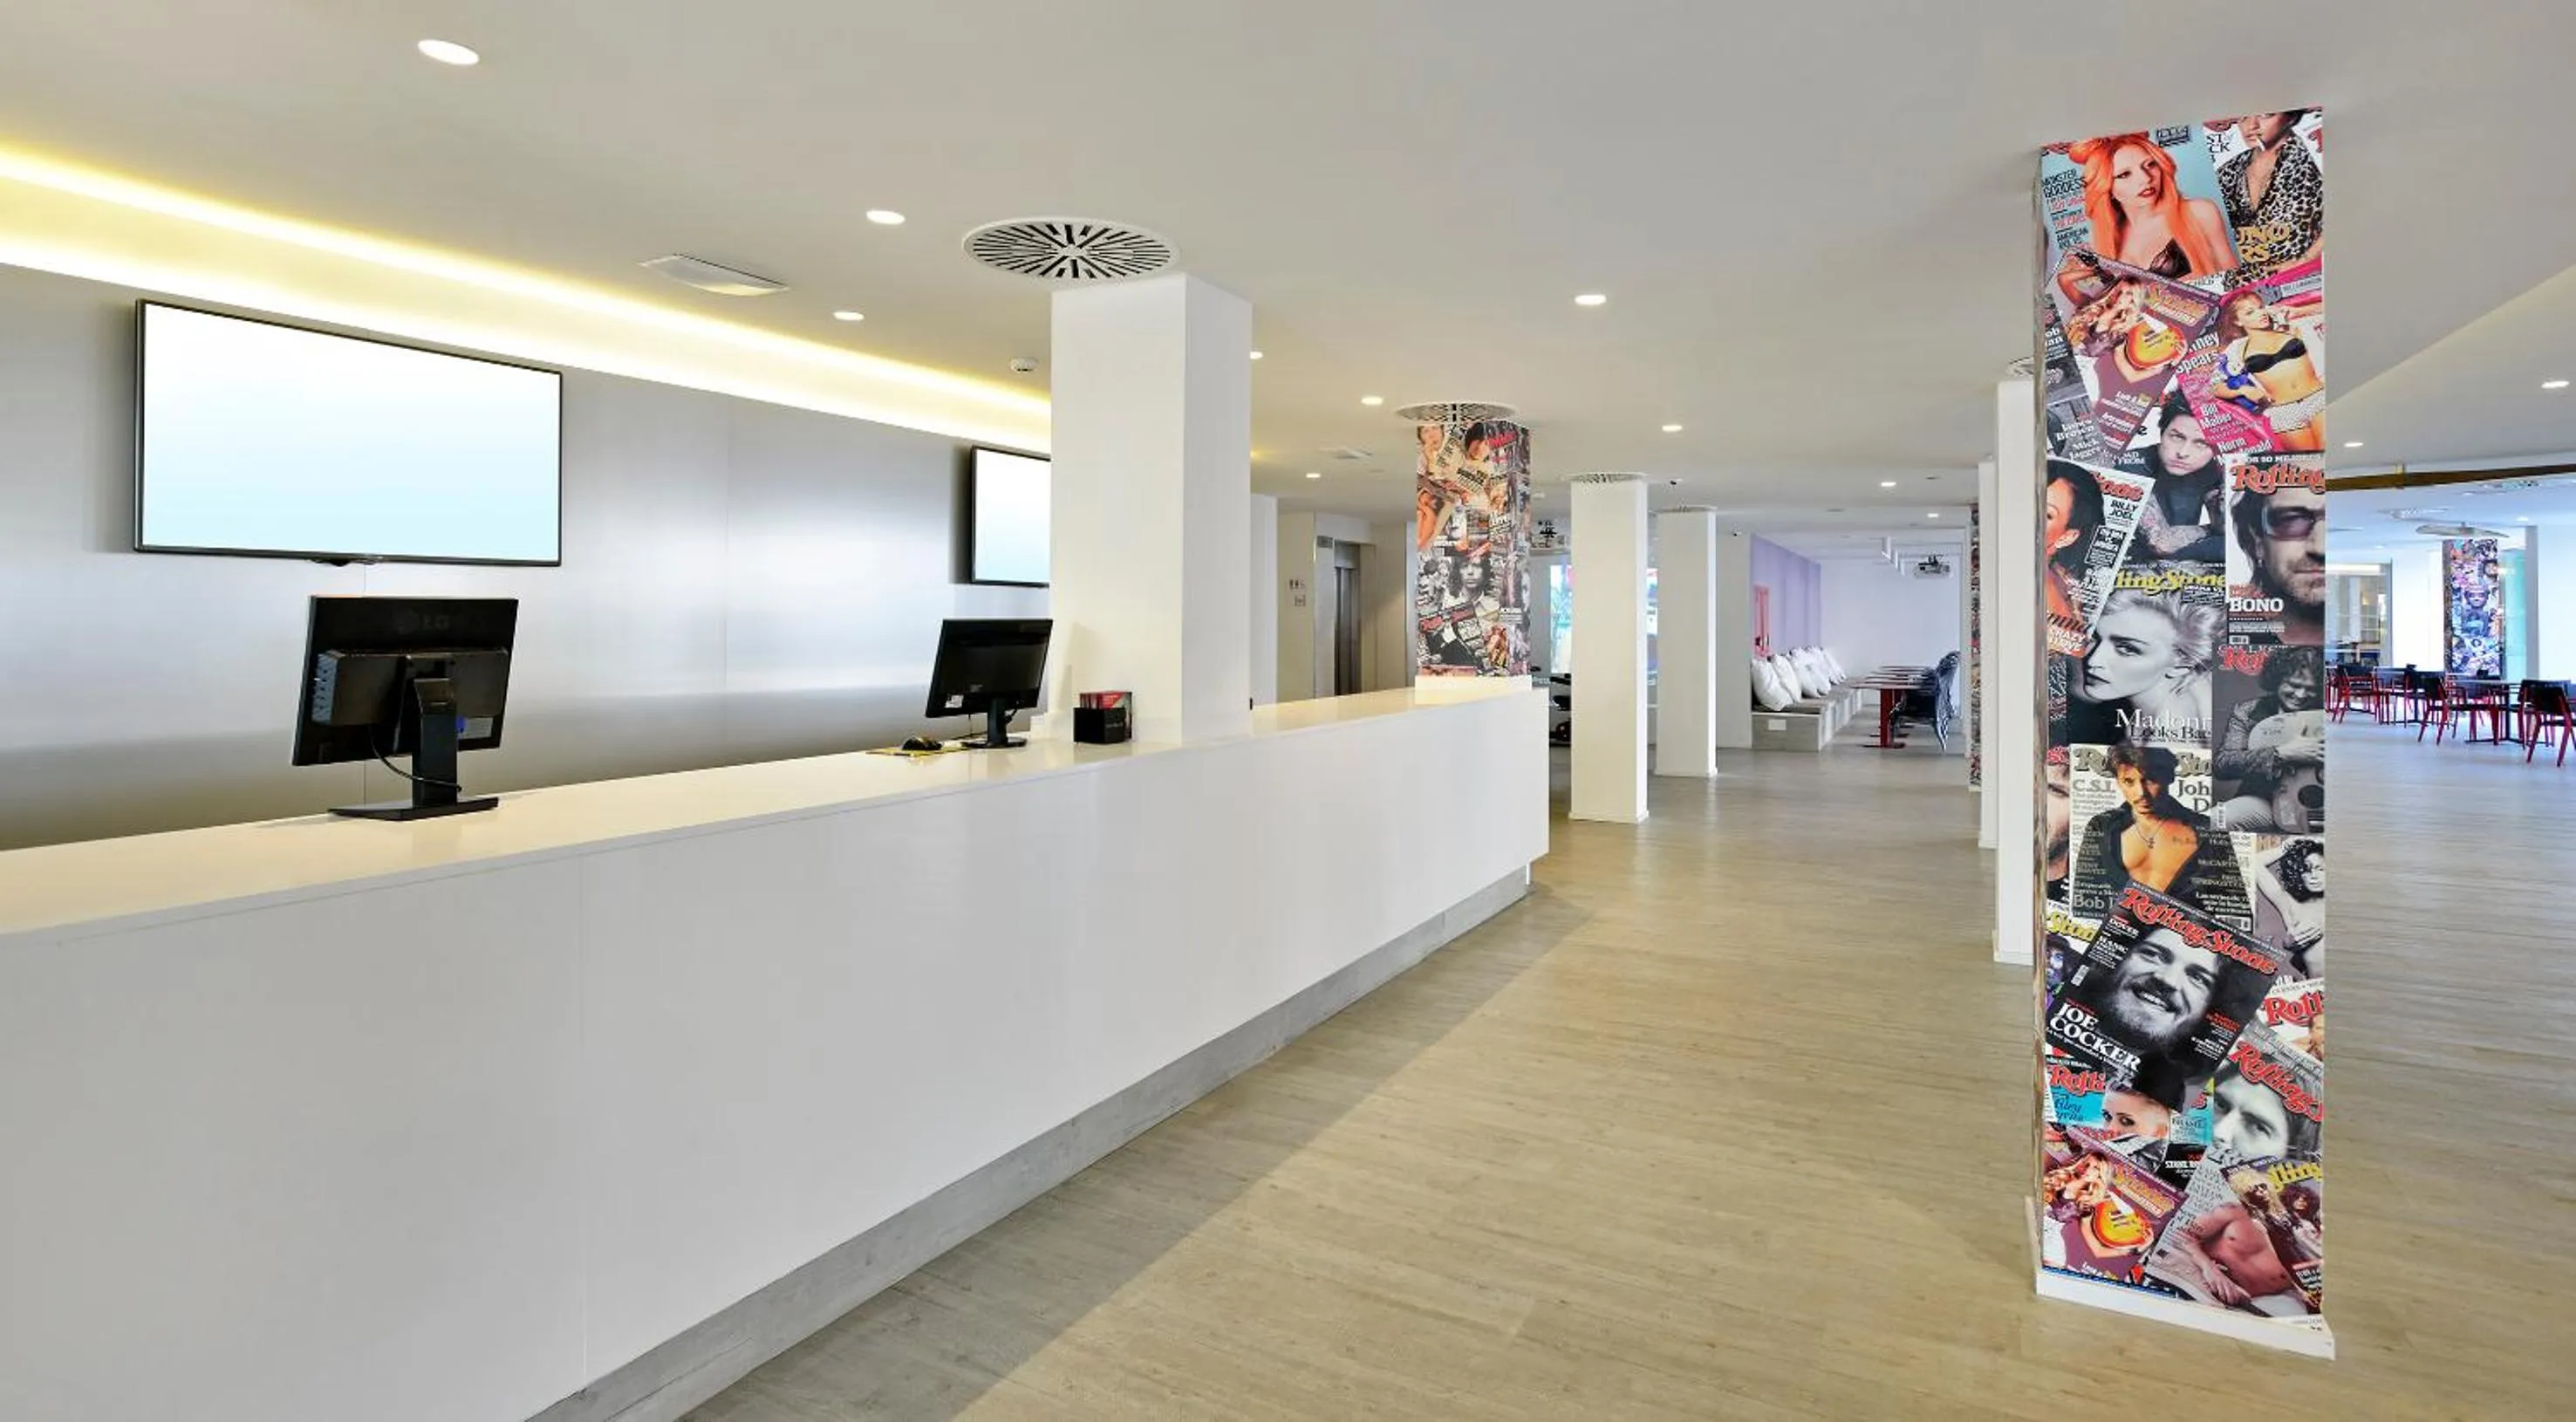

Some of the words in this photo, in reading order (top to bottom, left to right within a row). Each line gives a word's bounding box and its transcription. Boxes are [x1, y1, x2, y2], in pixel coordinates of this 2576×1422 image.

[2176, 349, 2220, 373] Spears
[2231, 463, 2326, 496] Rolling
[2109, 509, 2135, 522] JOEL
[2111, 500, 2138, 512] BILLY
[2230, 598, 2284, 612] BONO
[2129, 726, 2179, 740] Looks
[2177, 780, 2211, 797] Joh
[2074, 894, 2105, 909] Bob
[2119, 887, 2206, 948] Rolling
[2208, 929, 2279, 975] Stone
[2057, 1002, 2100, 1031] JOE
[2050, 1016, 2142, 1072] COCKER
[2226, 1039, 2312, 1115] Rolling
